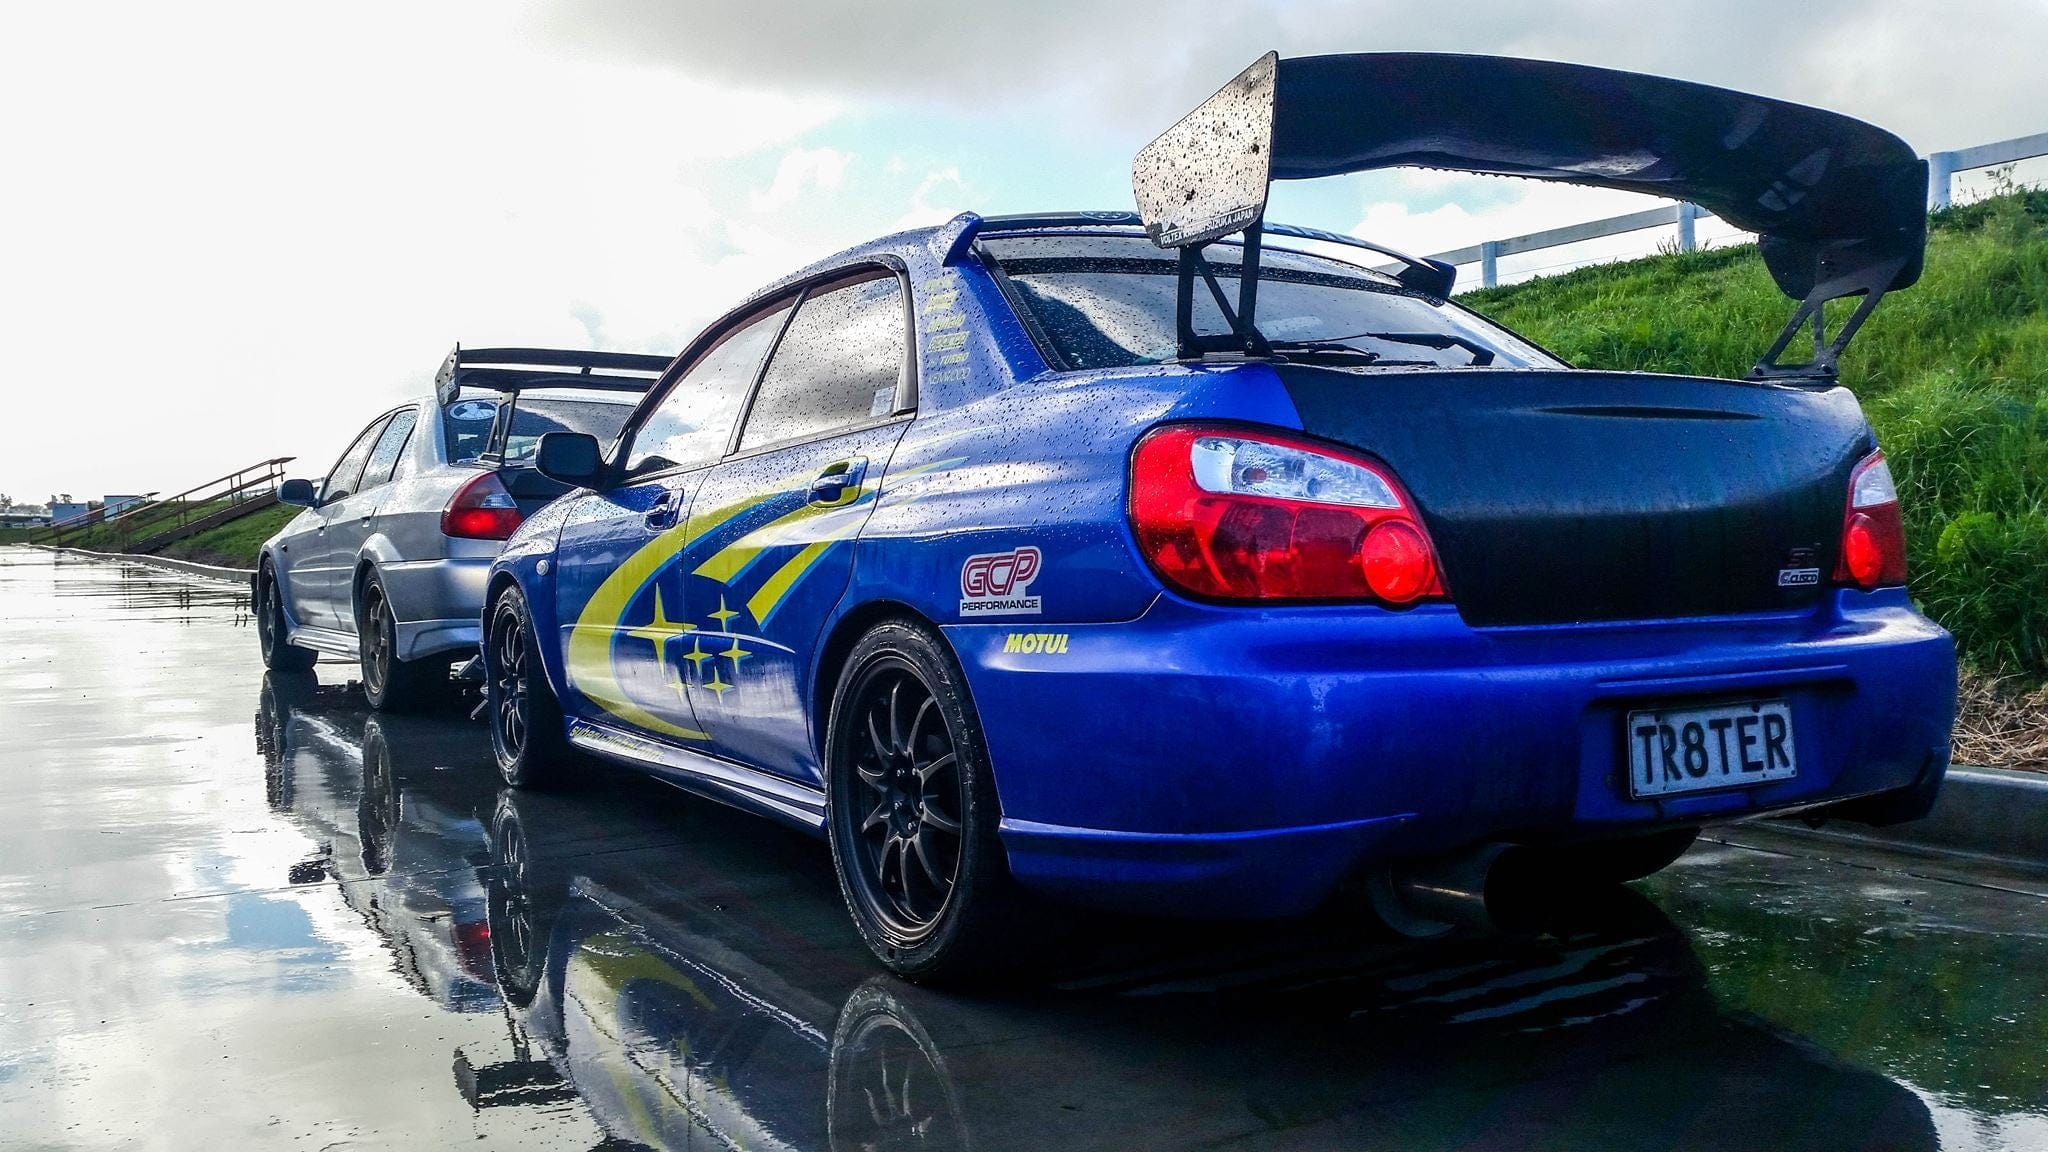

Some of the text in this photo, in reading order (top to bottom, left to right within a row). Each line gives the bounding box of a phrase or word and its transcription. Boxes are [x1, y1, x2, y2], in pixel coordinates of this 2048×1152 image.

[1160, 231, 1183, 245] VOLTEX
[1206, 215, 1232, 231] SUZUKA
[1232, 207, 1254, 223] JAPAN
[963, 548, 1039, 598] GCP
[962, 599, 1038, 611] PERFORMANCE
[1003, 633, 1069, 654] MOTUL
[1636, 714, 1791, 785] TR8TER
